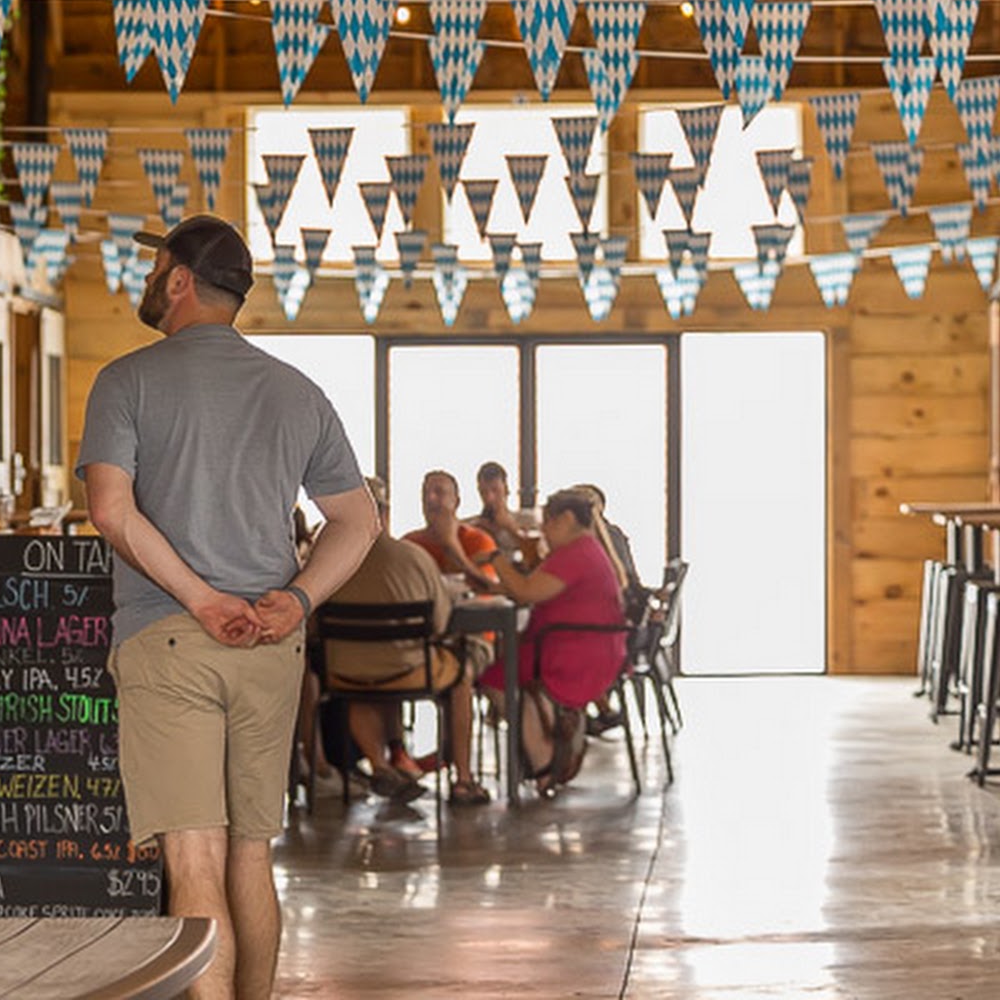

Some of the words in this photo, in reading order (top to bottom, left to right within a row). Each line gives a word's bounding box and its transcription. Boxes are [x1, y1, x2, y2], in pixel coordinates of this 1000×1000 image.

[23, 539, 64, 571] ON
[37, 615, 108, 648] LAGER
[35, 728, 89, 755] LAGER
[24, 803, 101, 835] PILSNER
